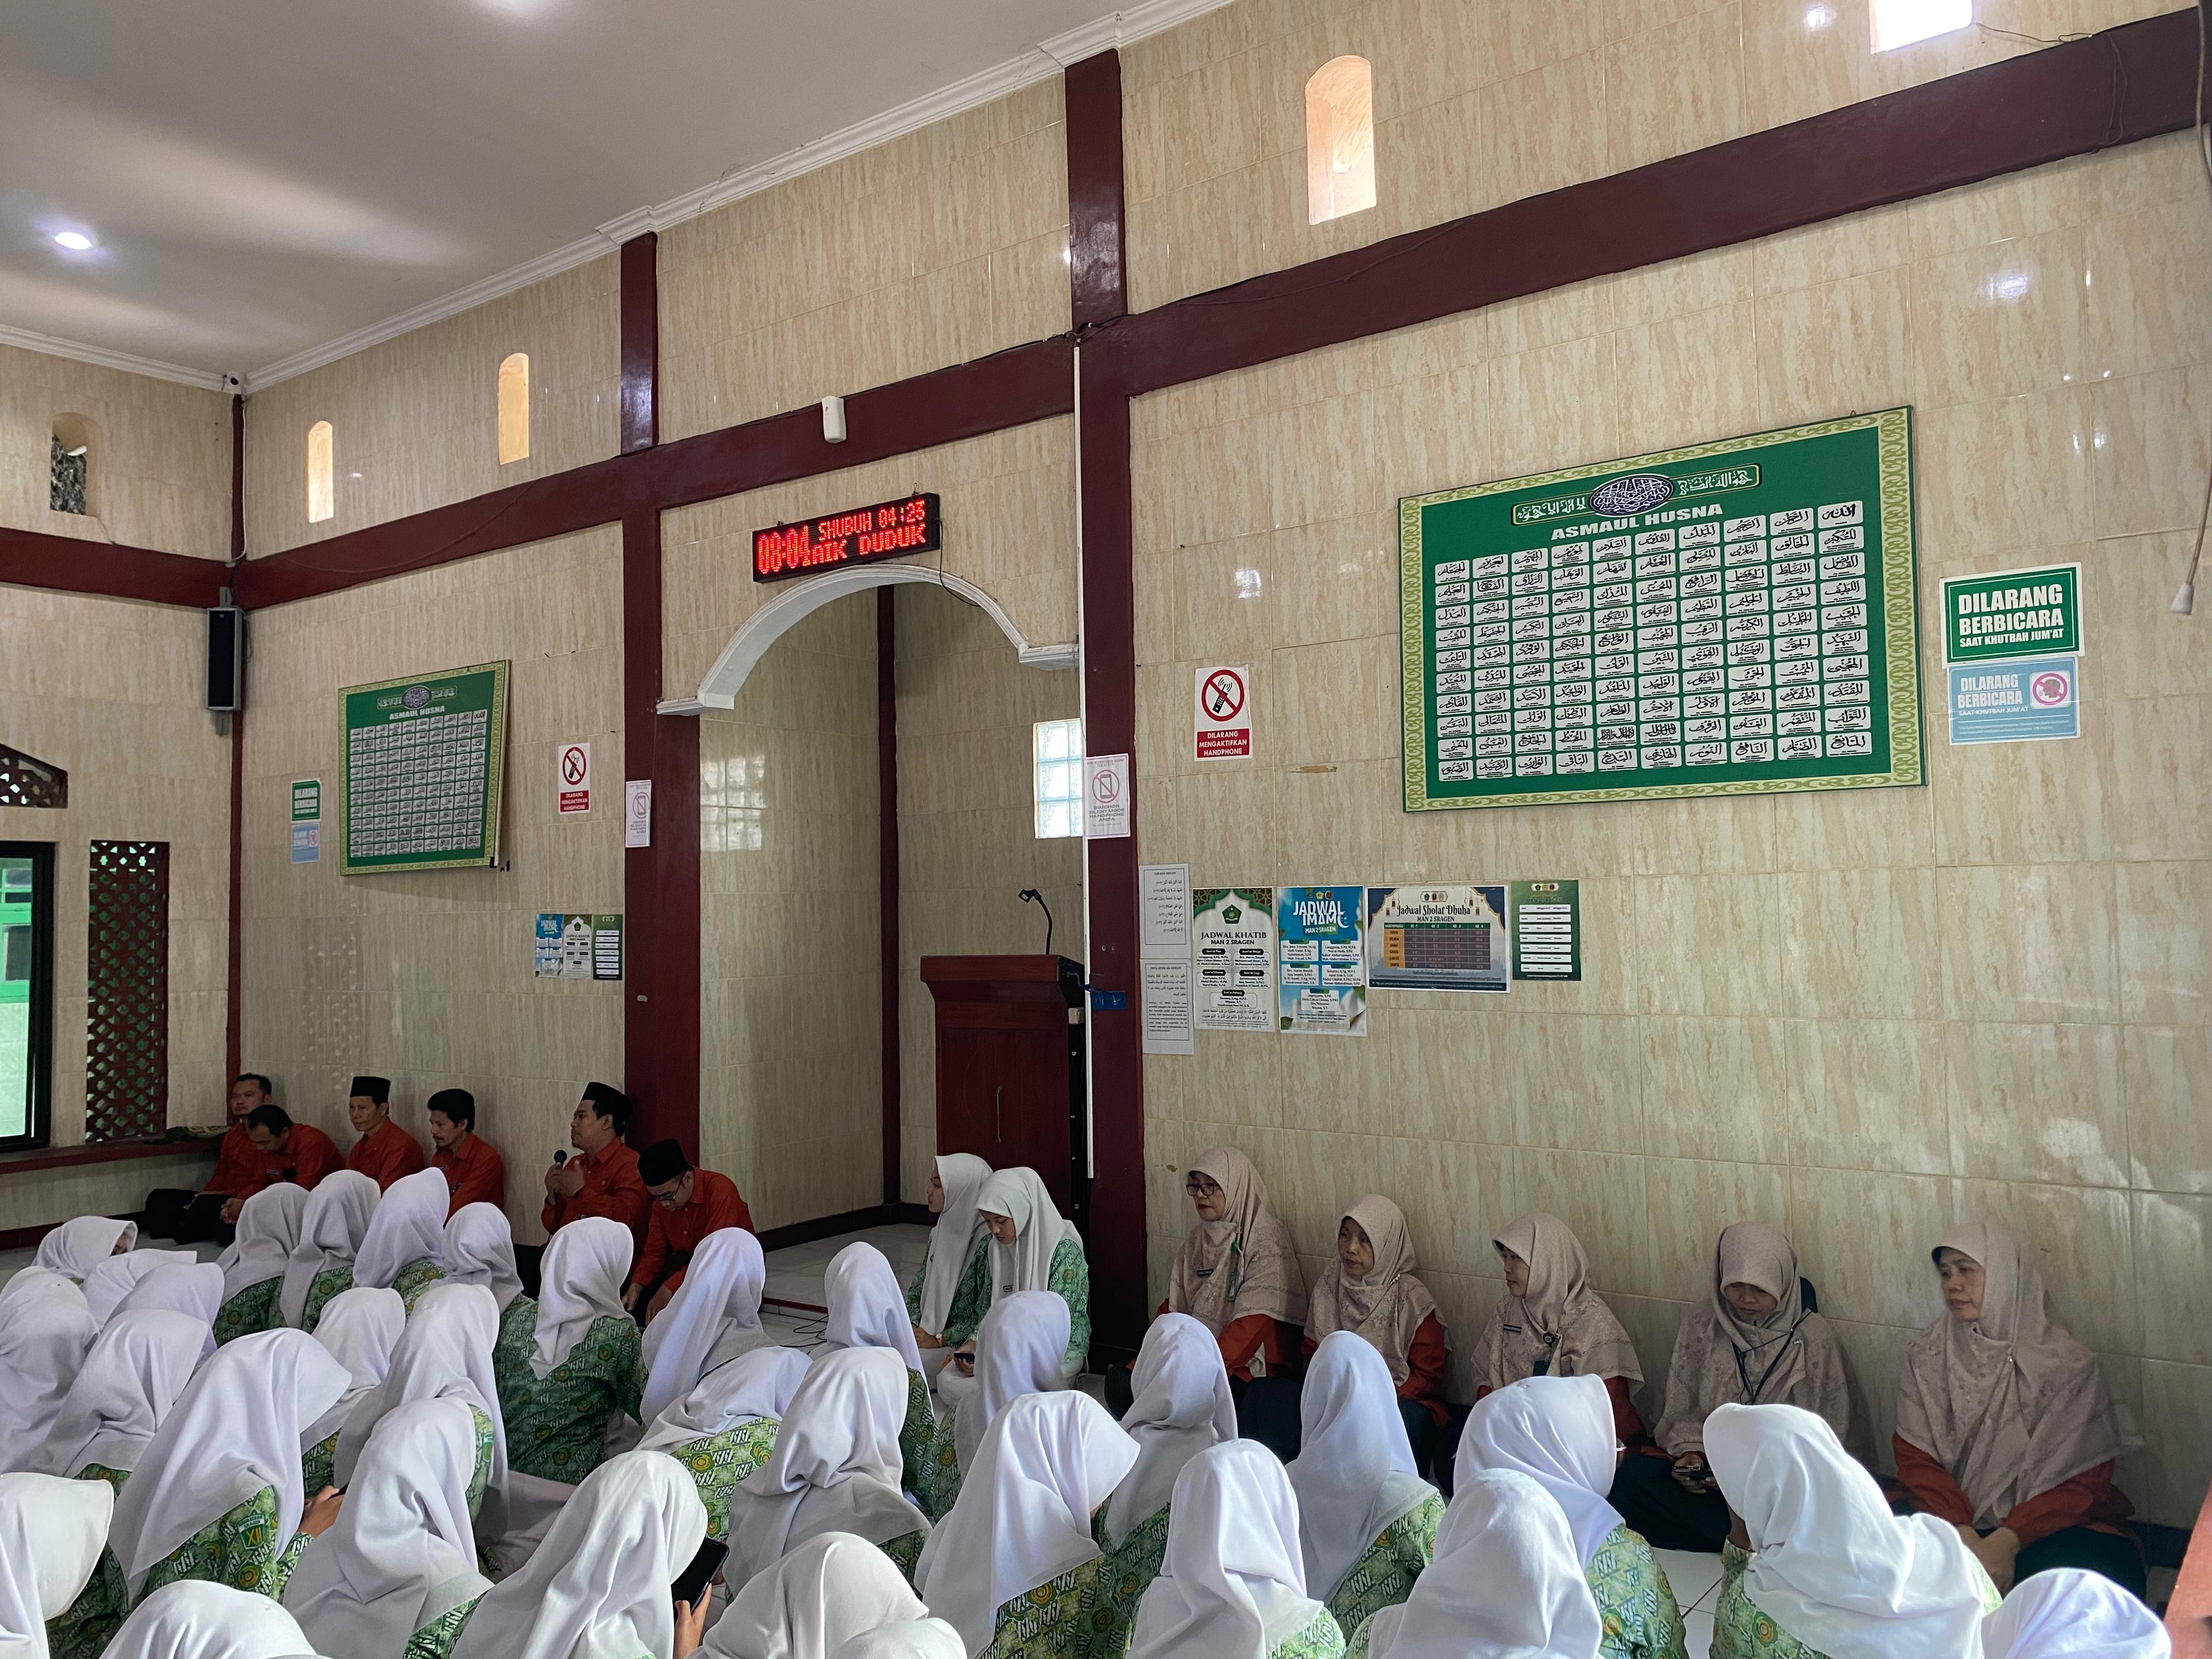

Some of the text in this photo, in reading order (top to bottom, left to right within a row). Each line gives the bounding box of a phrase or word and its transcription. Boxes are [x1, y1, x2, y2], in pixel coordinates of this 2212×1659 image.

[818, 511, 872, 541] SHUBUH
[1551, 504, 1724, 540] ASMAUL HUSNA
[859, 523, 926, 556] DUDUK
[1958, 584, 2063, 615] DILARANG
[1959, 608, 2064, 635] BERBICARA
[1960, 628, 2064, 648] SAAT KHUTBAH JUM'AT
[1960, 674, 2019, 692] DILARANG
[1957, 690, 2023, 709] BERBICARA
[390, 708, 419, 720] ASMAUL
[1207, 731, 1239, 739] DILARANG
[1199, 739, 1247, 748] MENGAKTIFKAN
[1204, 748, 1243, 757] HANDPHONE
[1293, 901, 1345, 916] JADWAL
[1397, 905, 1471, 917] Jadwal Sholat Dhuha
[1302, 913, 1338, 926] IMAM
[1200, 932, 1233, 940] JADWAL
